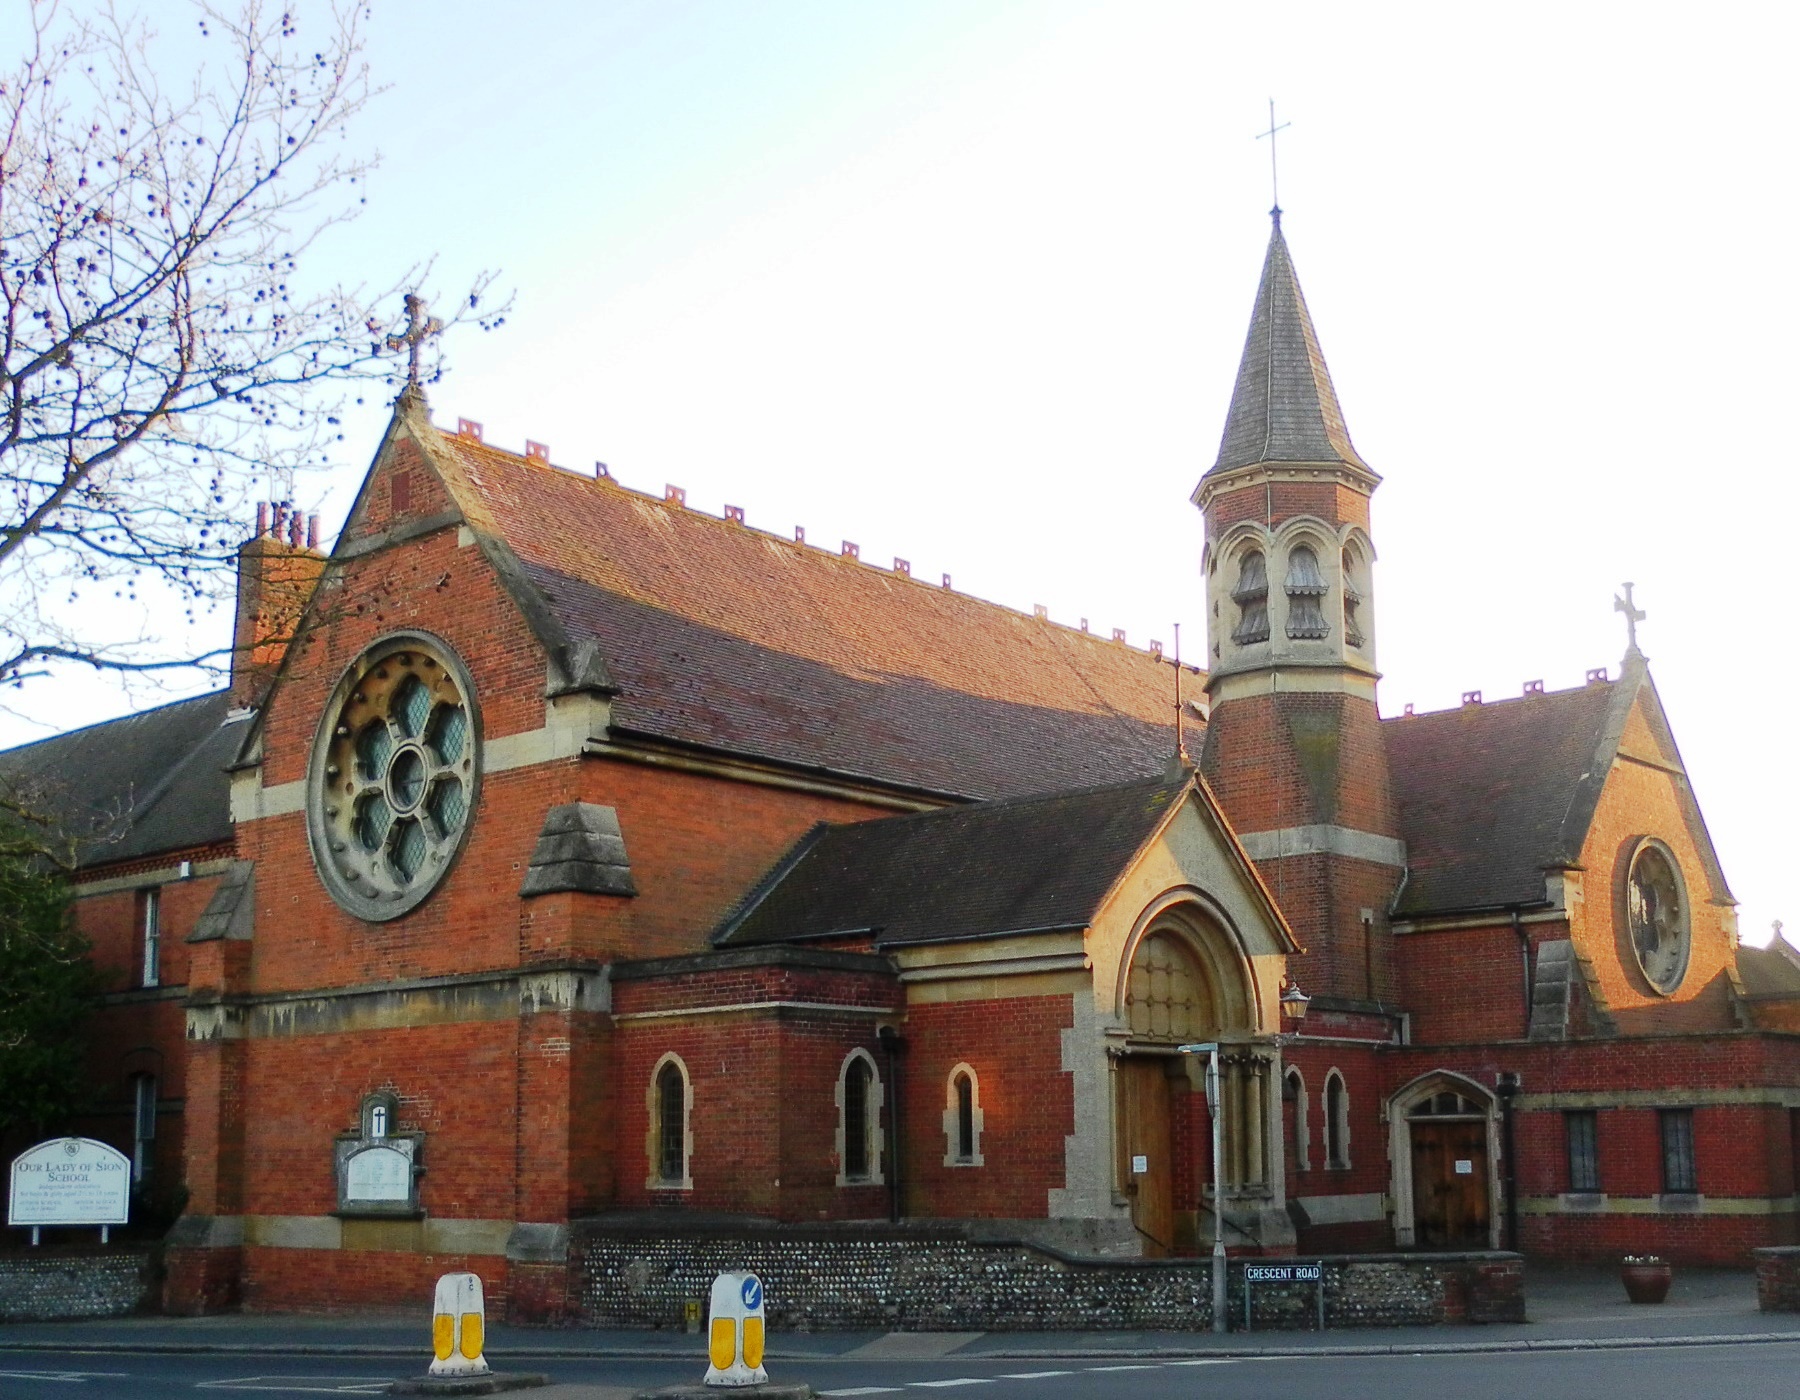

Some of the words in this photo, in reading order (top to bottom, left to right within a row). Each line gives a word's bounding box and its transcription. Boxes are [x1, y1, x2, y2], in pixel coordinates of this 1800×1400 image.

[46, 1162, 77, 1172] LADY
[48, 1172, 89, 1182] SCHOOL
[1247, 1268, 1291, 1279] CRESCENT
[1296, 1267, 1319, 1278] ROAD
